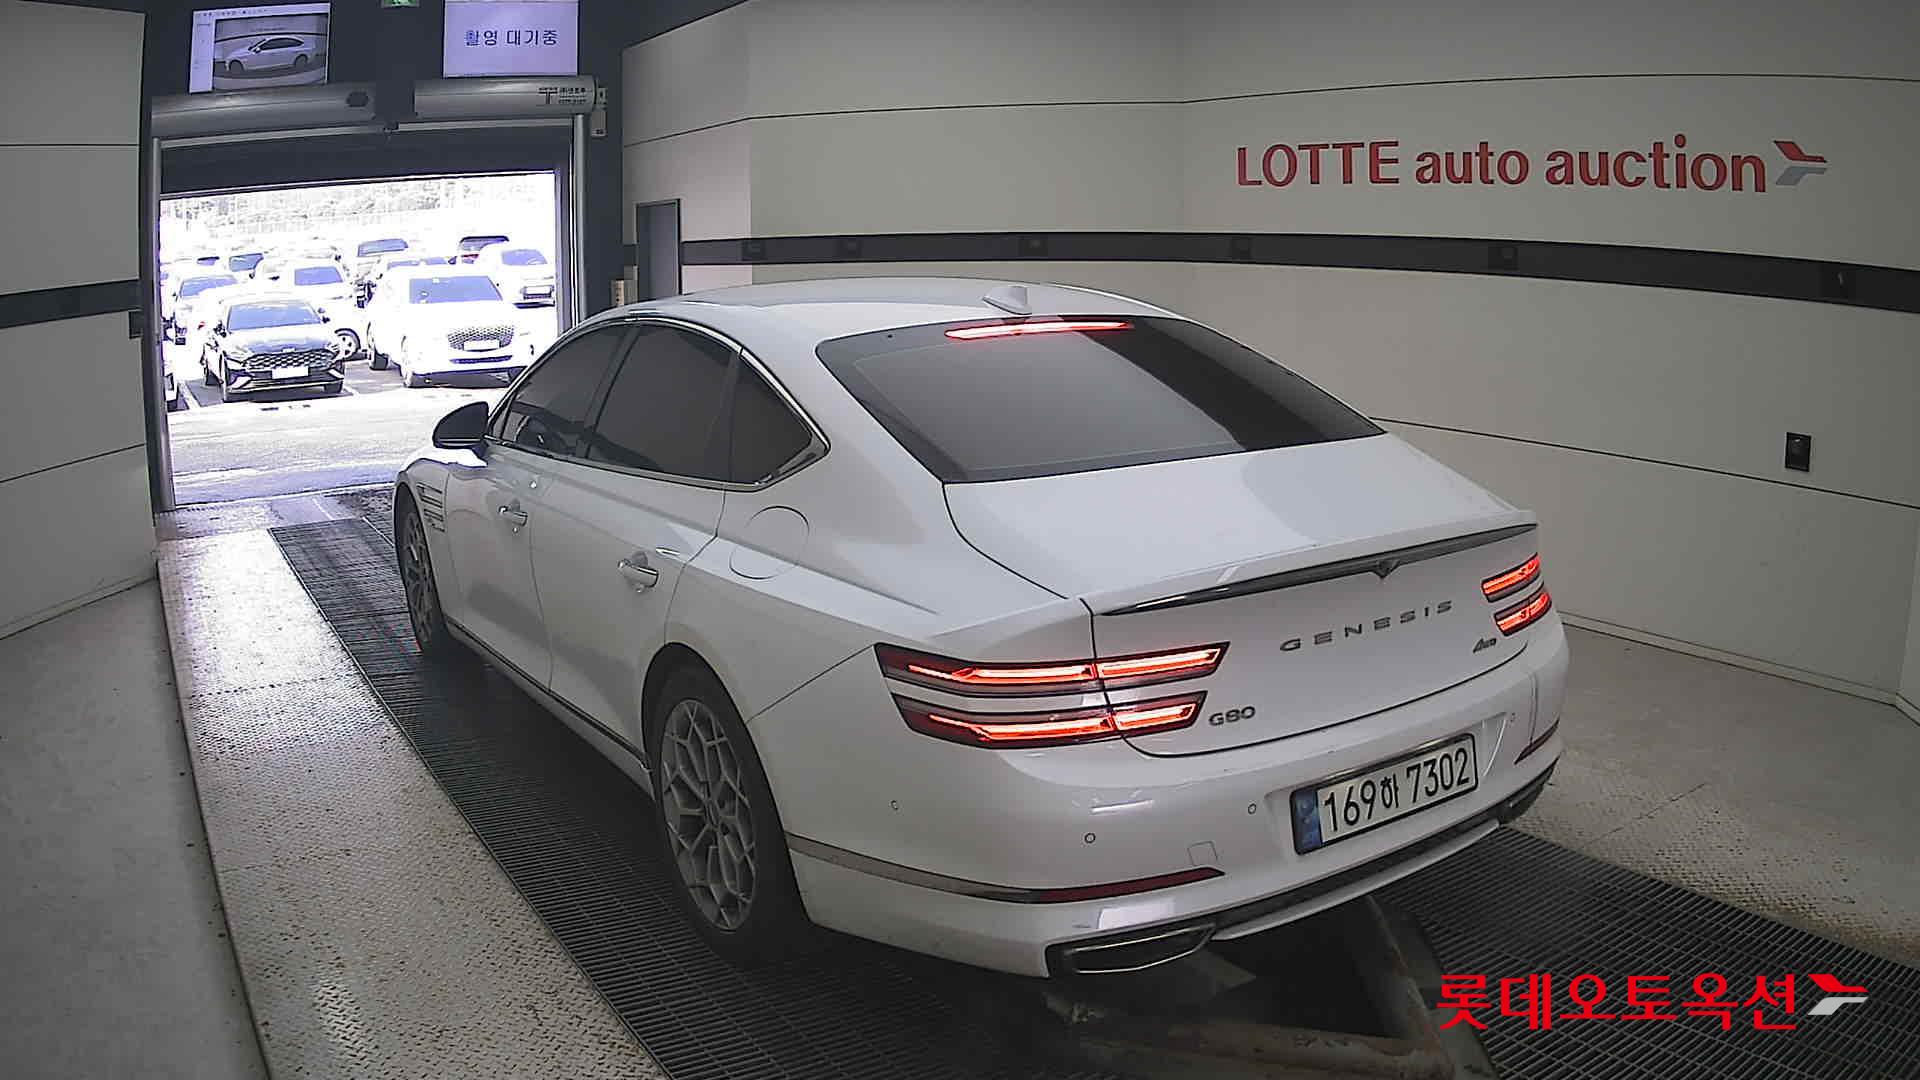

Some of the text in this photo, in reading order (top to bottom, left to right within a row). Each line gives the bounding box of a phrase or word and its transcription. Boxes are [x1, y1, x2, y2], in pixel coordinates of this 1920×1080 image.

[506, 30, 558, 46] 대기중
[1237, 134, 1767, 193] LOTTE auto auction
[1280, 600, 1452, 651] GENESIS
[1209, 706, 1256, 726] G80
[1324, 748, 1470, 832] 169하 7302
